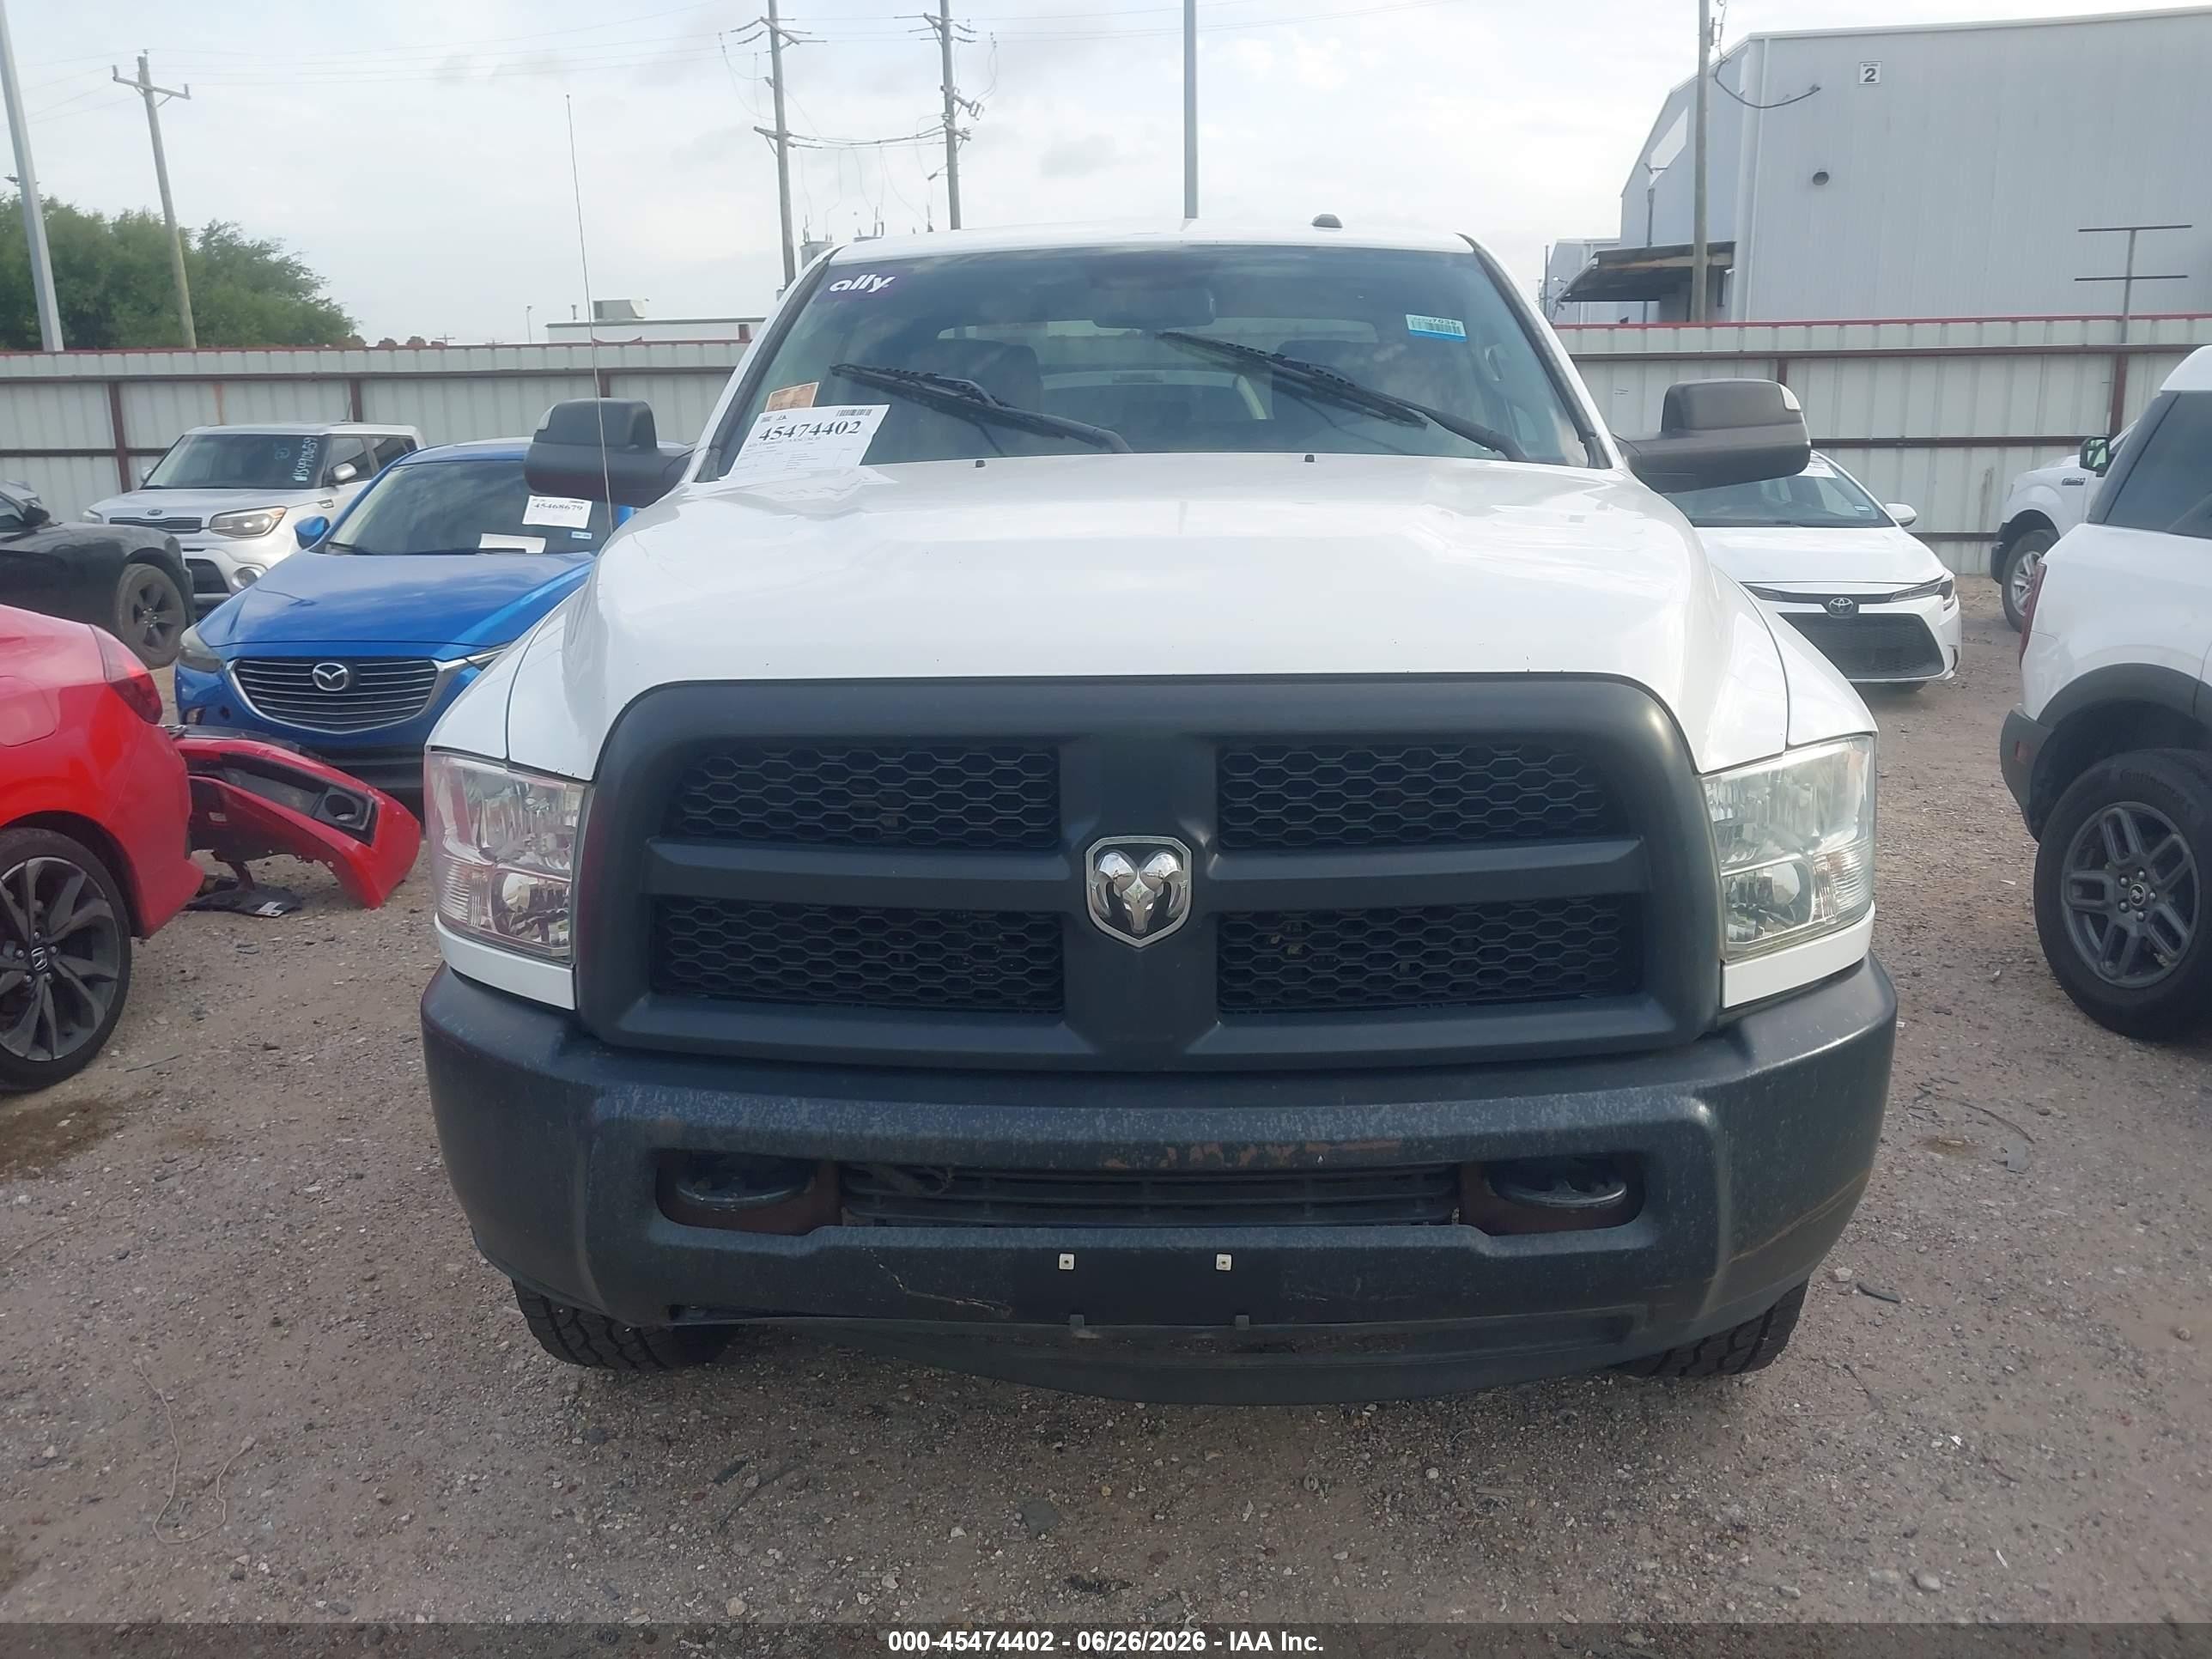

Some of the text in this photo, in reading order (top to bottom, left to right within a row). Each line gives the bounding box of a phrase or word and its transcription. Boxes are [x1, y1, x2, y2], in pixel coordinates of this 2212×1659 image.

[1863, 67, 1876, 83] 2
[829, 274, 896, 294] ally
[758, 420, 861, 441] 45474402
